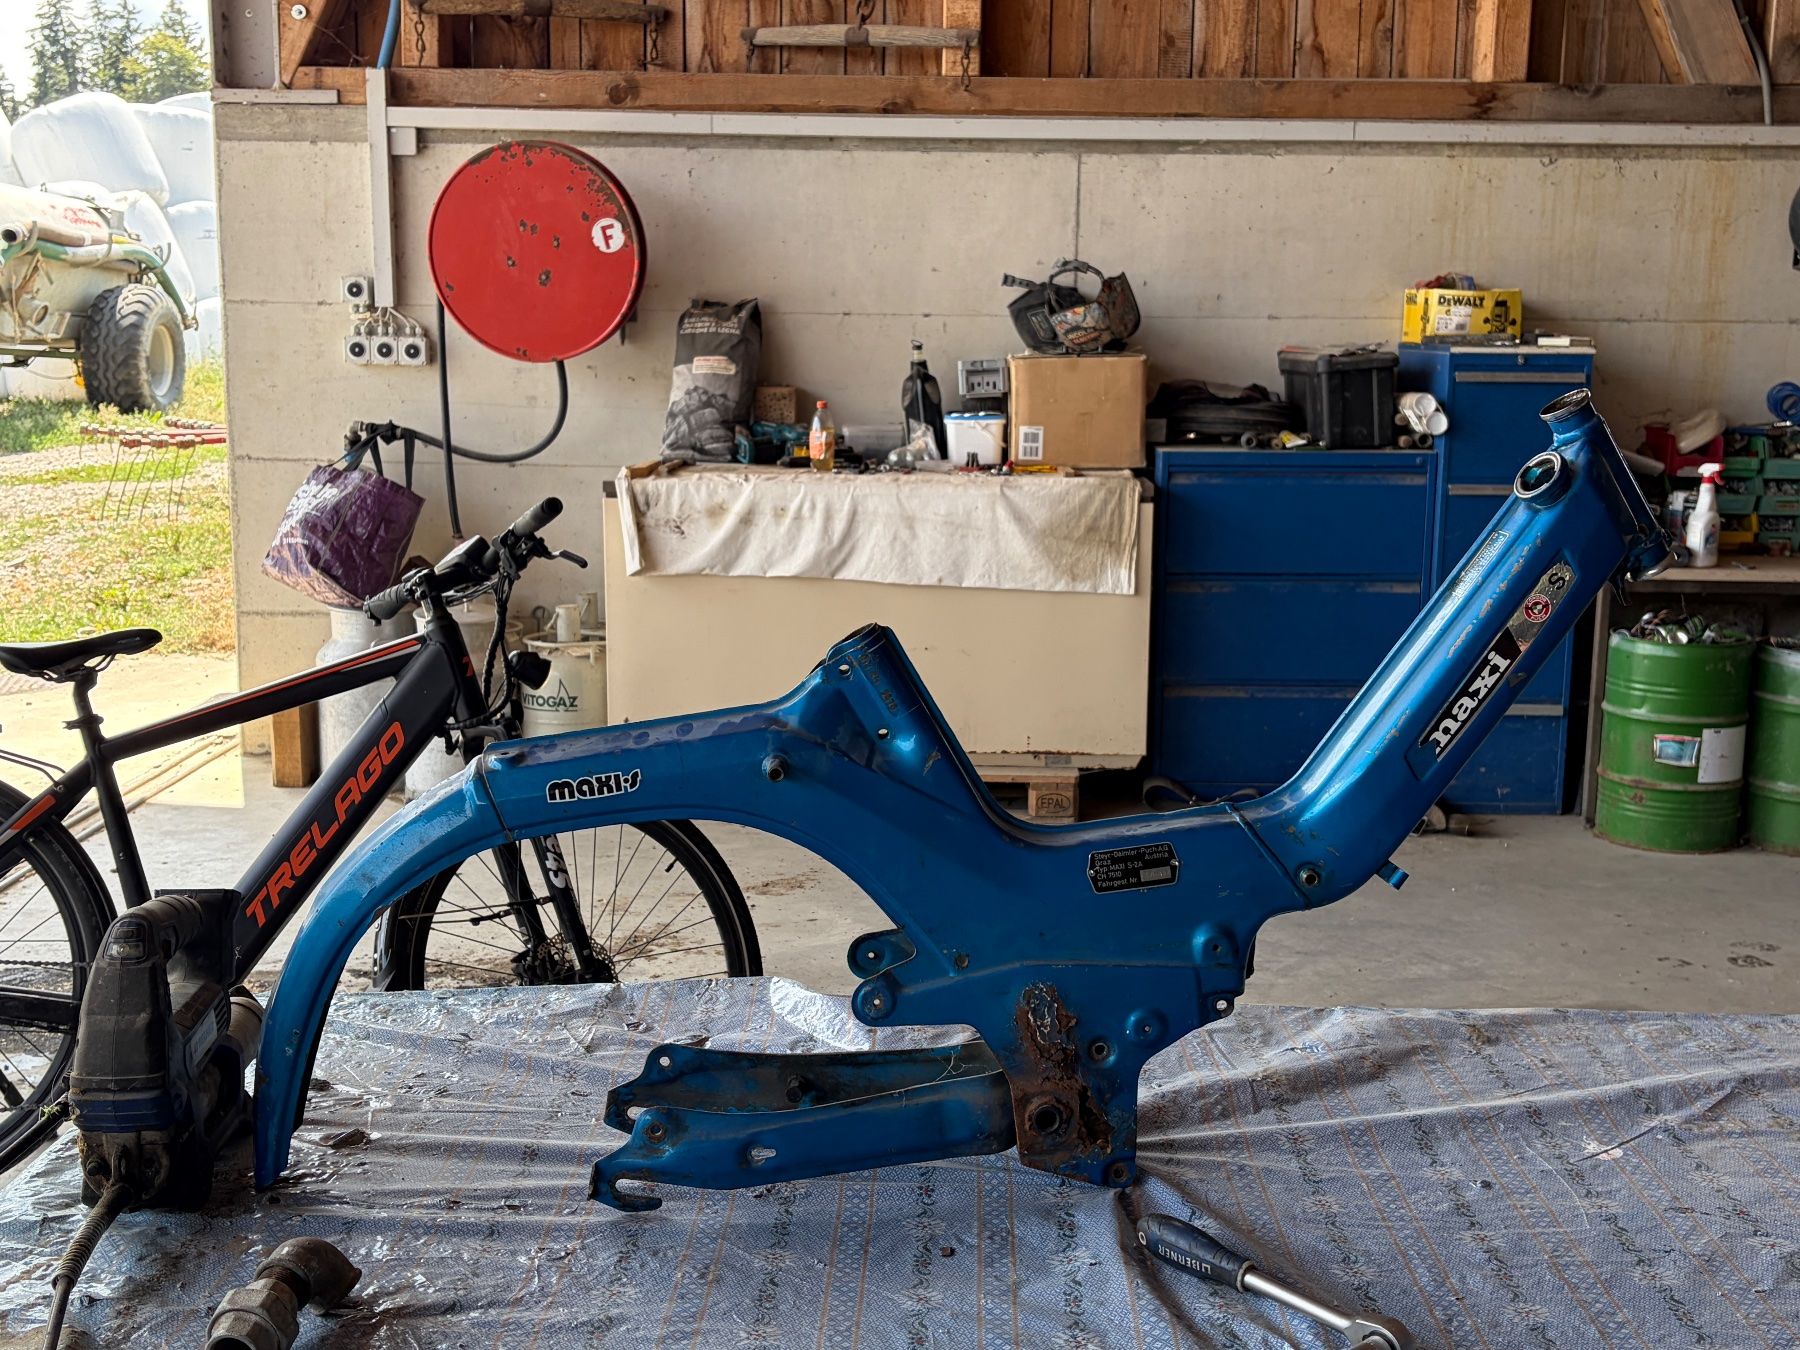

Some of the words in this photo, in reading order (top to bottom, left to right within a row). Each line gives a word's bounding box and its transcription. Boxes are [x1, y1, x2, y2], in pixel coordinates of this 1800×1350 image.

[600, 223, 615, 250] F
[1548, 572, 1566, 590] S
[522, 693, 579, 708] VITOGAZ
[1040, 797, 1067, 809] EPAL
[245, 721, 405, 928] TRELAGO
[1144, 852, 1169, 860] Austria
[1158, 1244, 1200, 1271] BERNER
